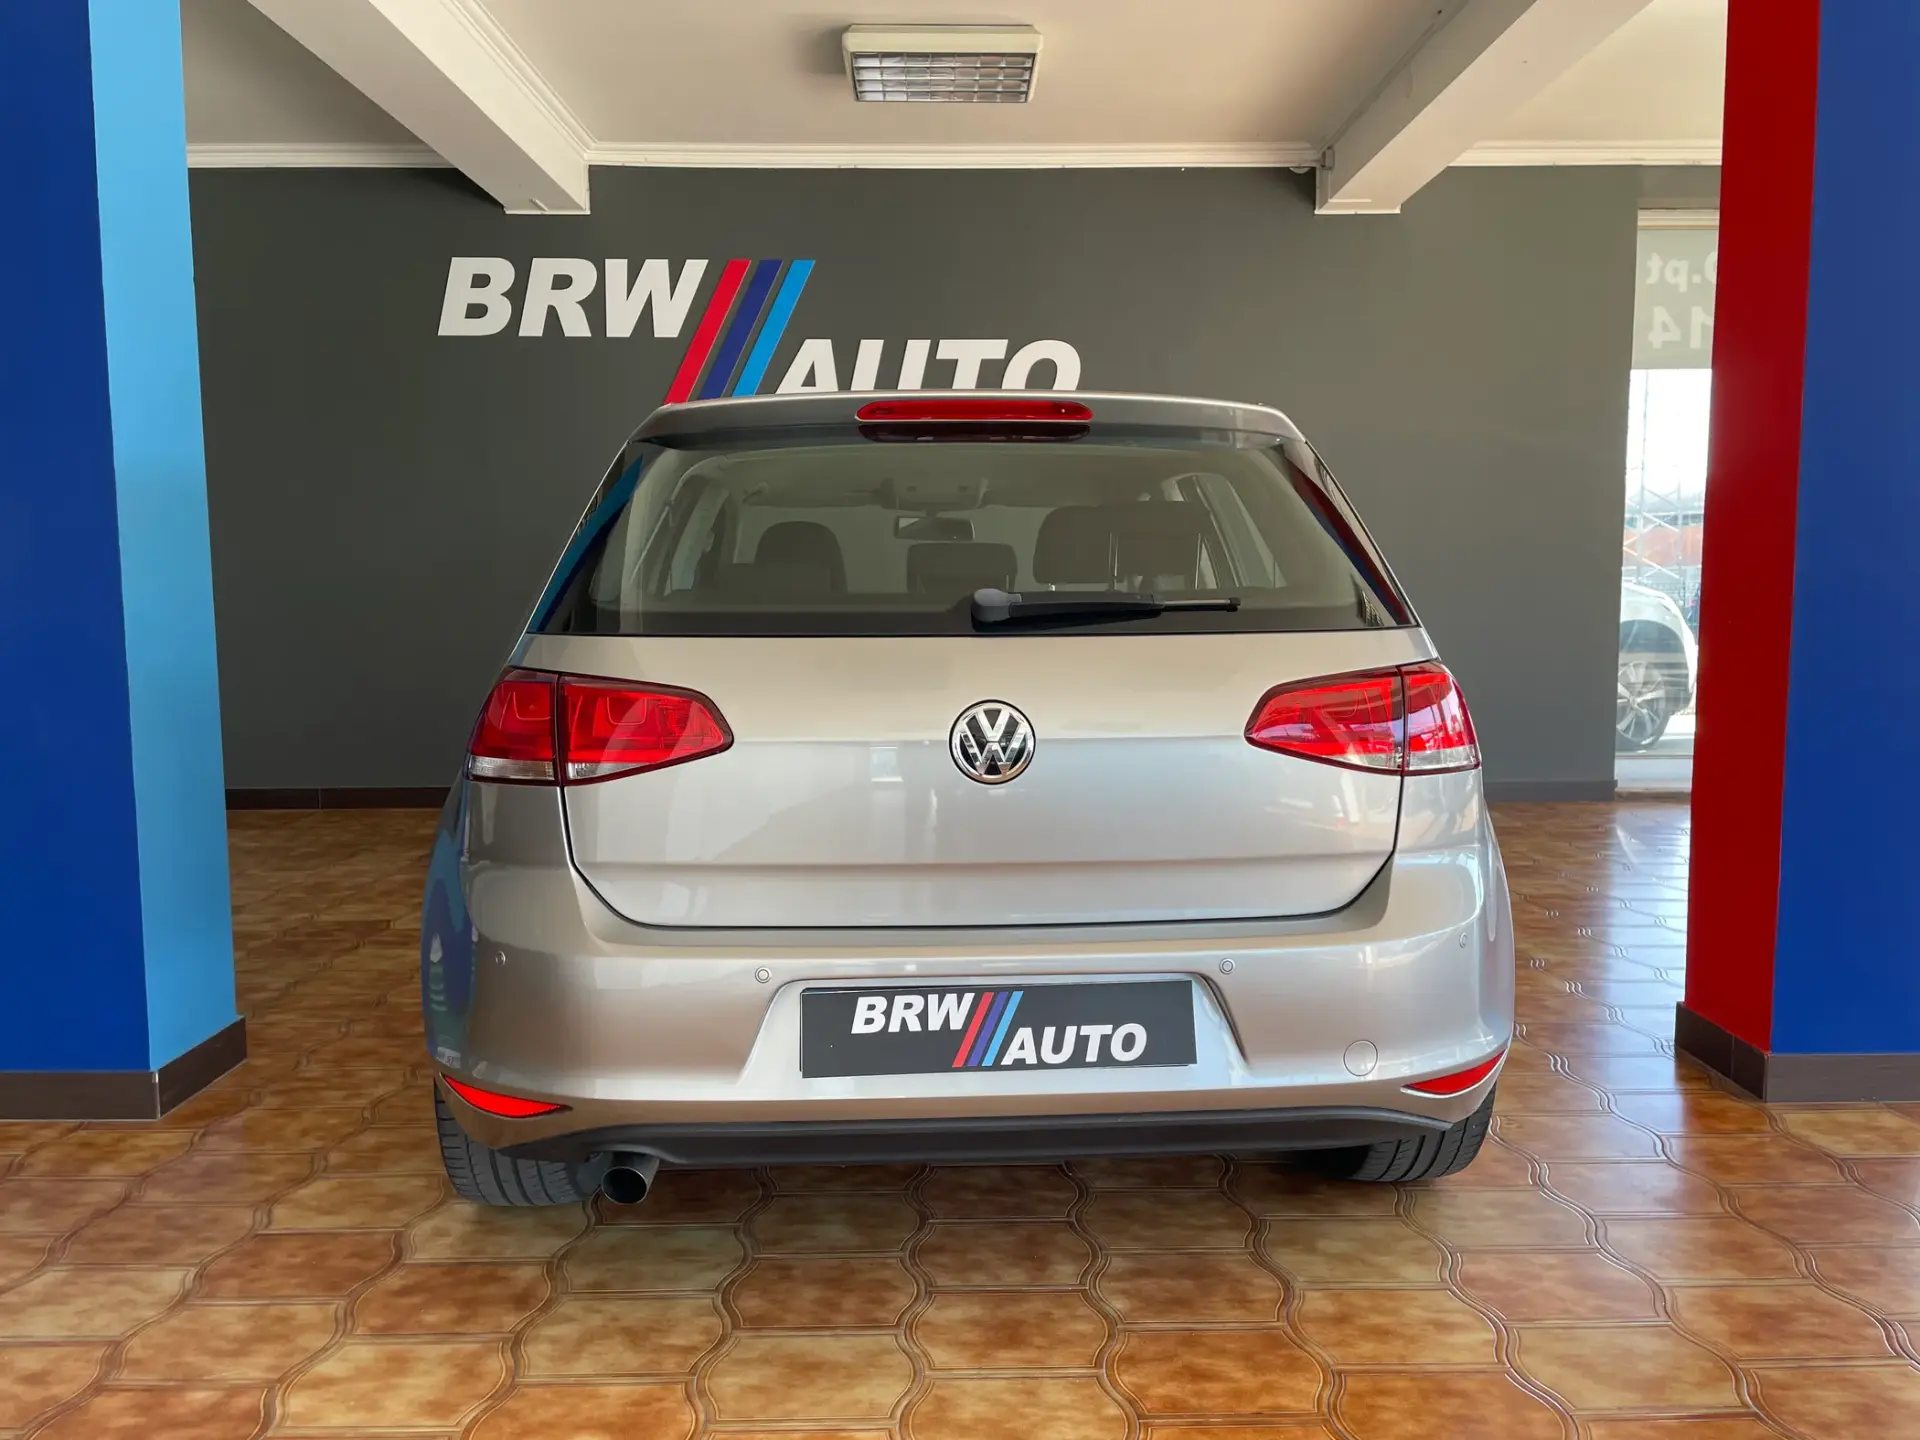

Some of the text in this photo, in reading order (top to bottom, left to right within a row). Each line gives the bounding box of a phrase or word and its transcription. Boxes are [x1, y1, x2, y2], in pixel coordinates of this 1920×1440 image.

[437, 257, 708, 338] BRW
[775, 338, 1081, 393] AUTO
[851, 993, 975, 1034] BRW
[1001, 1023, 1147, 1066] AUTO
